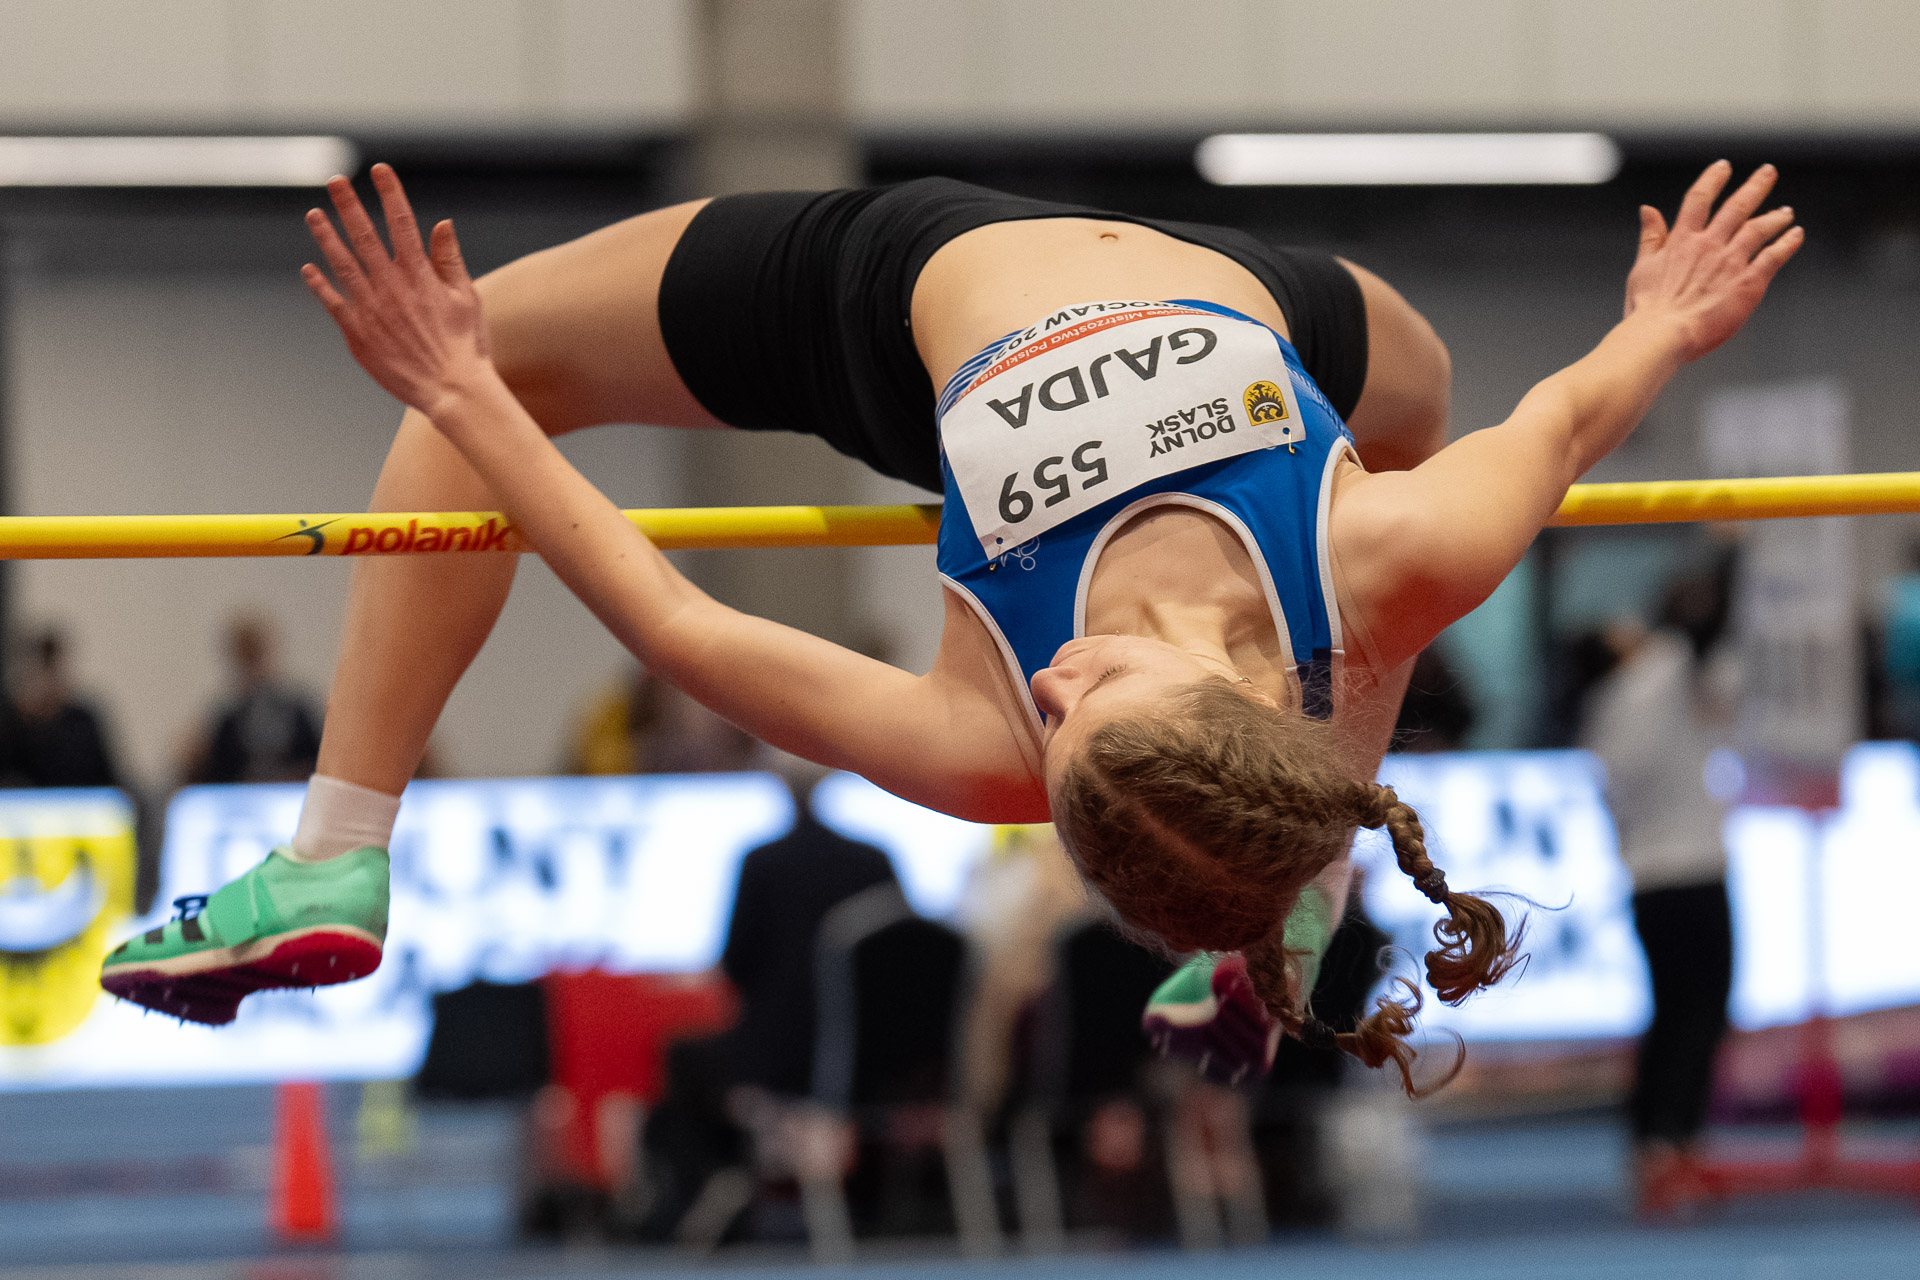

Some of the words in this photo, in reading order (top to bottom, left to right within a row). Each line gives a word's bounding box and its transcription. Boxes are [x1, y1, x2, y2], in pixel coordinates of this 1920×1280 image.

[1045, 302, 1192, 331] OCŁAW
[1051, 311, 1143, 345] Mistrzostwa
[980, 364, 1004, 382] U18
[1005, 341, 1048, 369] Polski
[986, 328, 1217, 429] GAJDA
[1145, 398, 1229, 439] ŚLĄSK
[1149, 414, 1236, 459] DOLNY
[998, 441, 1109, 524] 559
[341, 518, 514, 556] polanik
